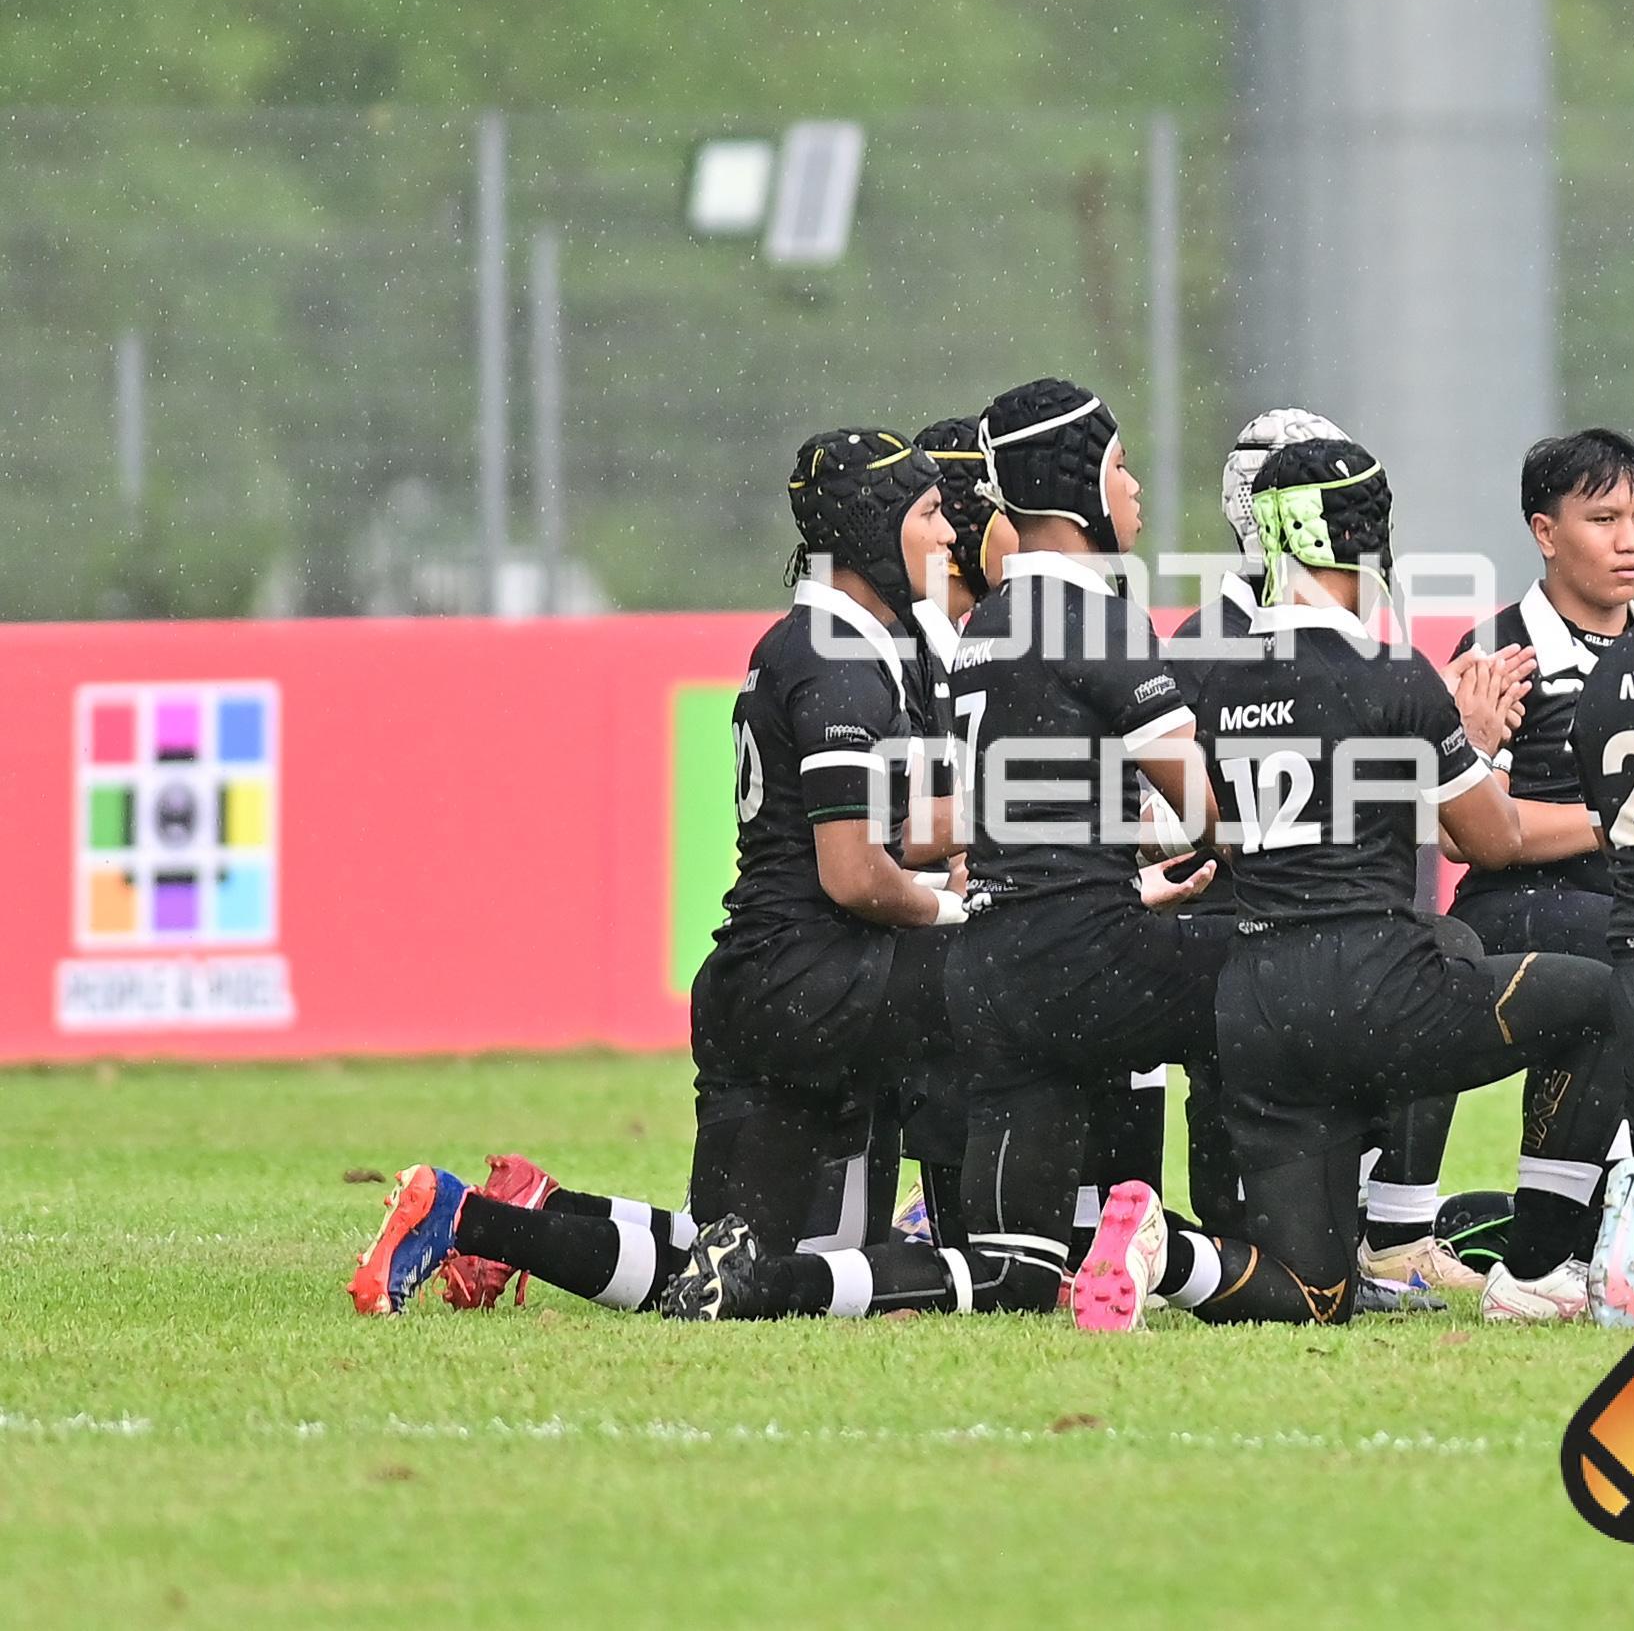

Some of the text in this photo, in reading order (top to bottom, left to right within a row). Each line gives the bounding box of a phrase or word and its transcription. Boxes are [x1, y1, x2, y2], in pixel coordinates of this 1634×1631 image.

[955, 690, 987, 792] 7
[1220, 699, 1295, 731] MCKK
[733, 720, 764, 823] 0
[1220, 749, 1322, 854] 12
